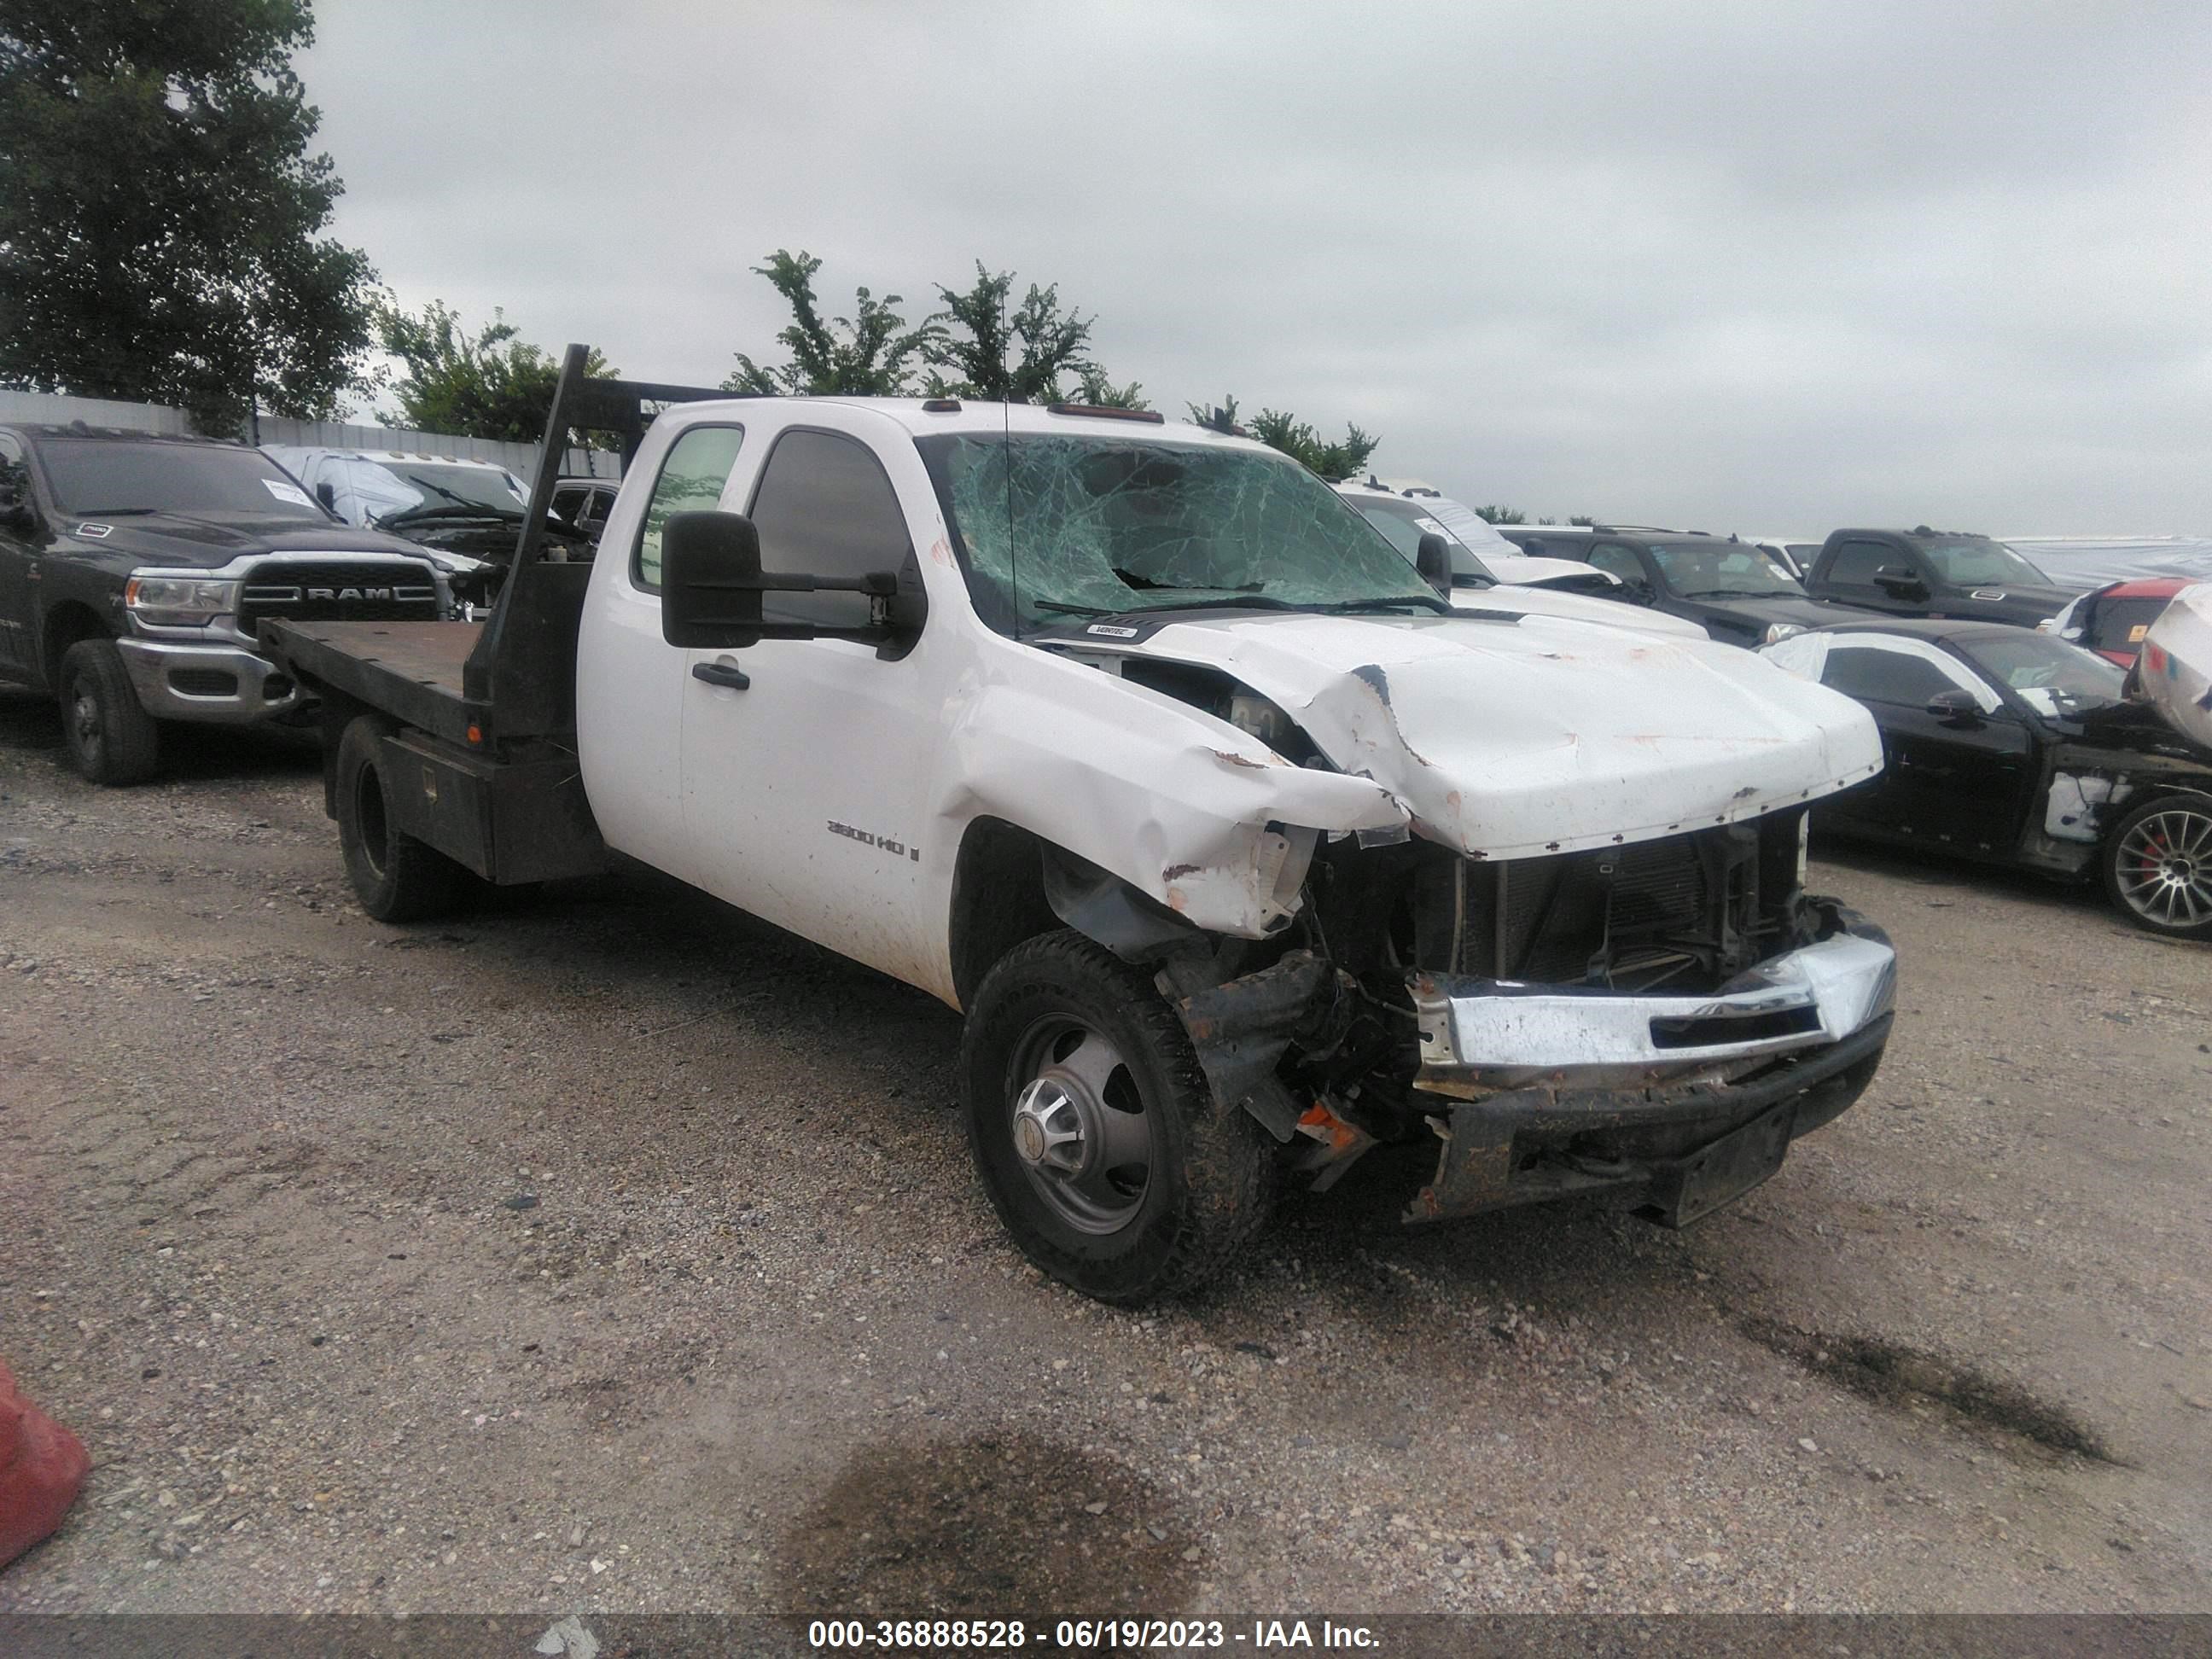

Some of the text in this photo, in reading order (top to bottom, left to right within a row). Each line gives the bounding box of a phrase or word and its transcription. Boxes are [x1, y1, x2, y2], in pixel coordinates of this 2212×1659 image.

[307, 588, 390, 600] RAM
[1095, 626, 1130, 636] VORTEC
[876, 835, 905, 856] HD
